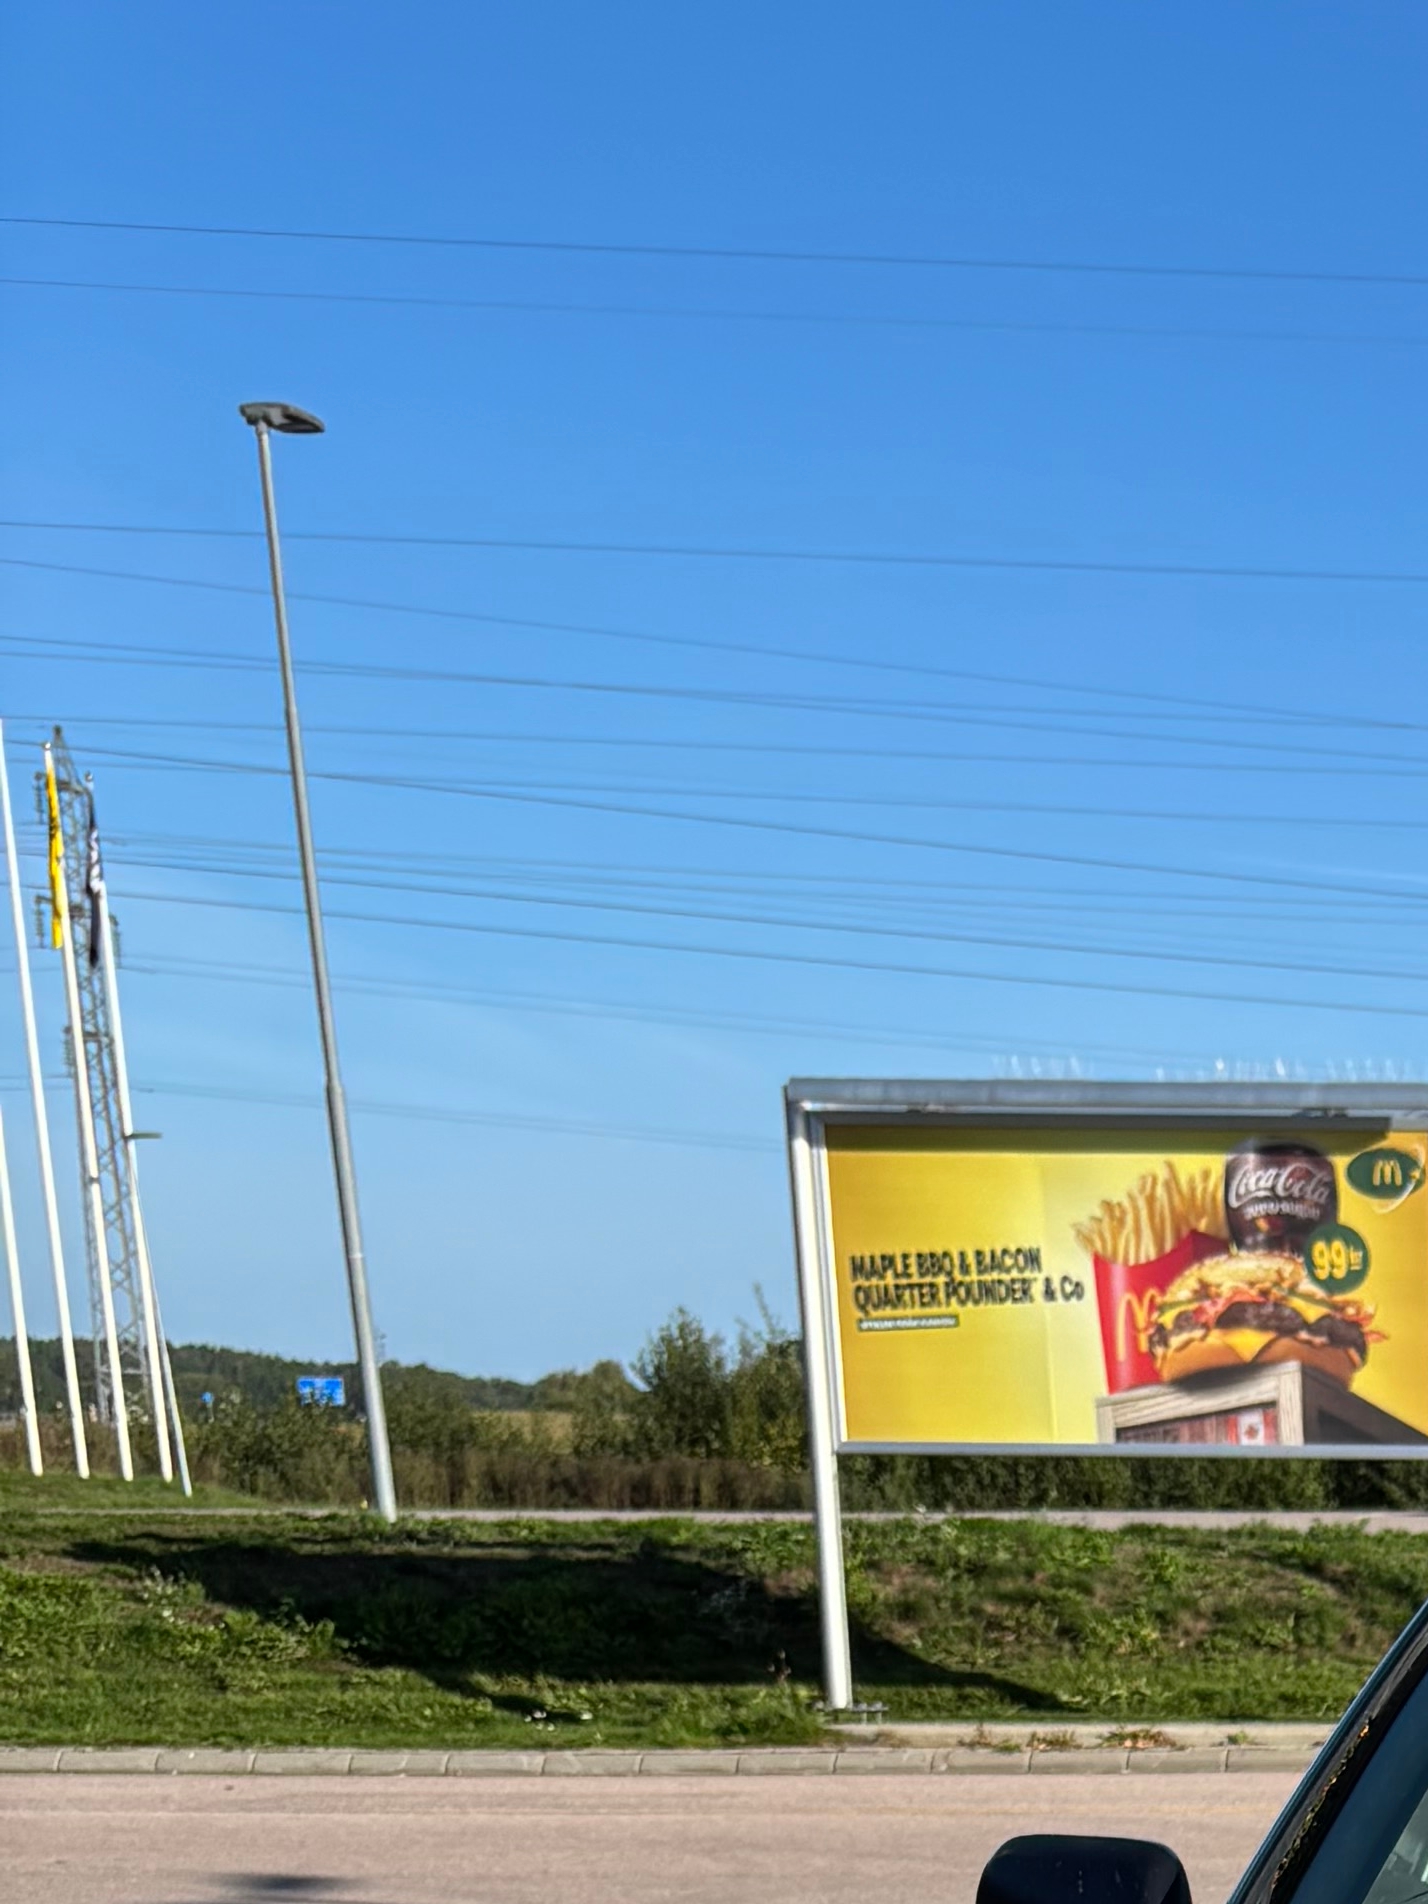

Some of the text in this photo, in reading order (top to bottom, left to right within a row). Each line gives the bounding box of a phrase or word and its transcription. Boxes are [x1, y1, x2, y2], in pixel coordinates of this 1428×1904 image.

[850, 1247, 1043, 1282] MAPLE BBQ & BACON
[1311, 1240, 1347, 1280] 99
[853, 1275, 1085, 1316] QUARTER POUNDER & Co
